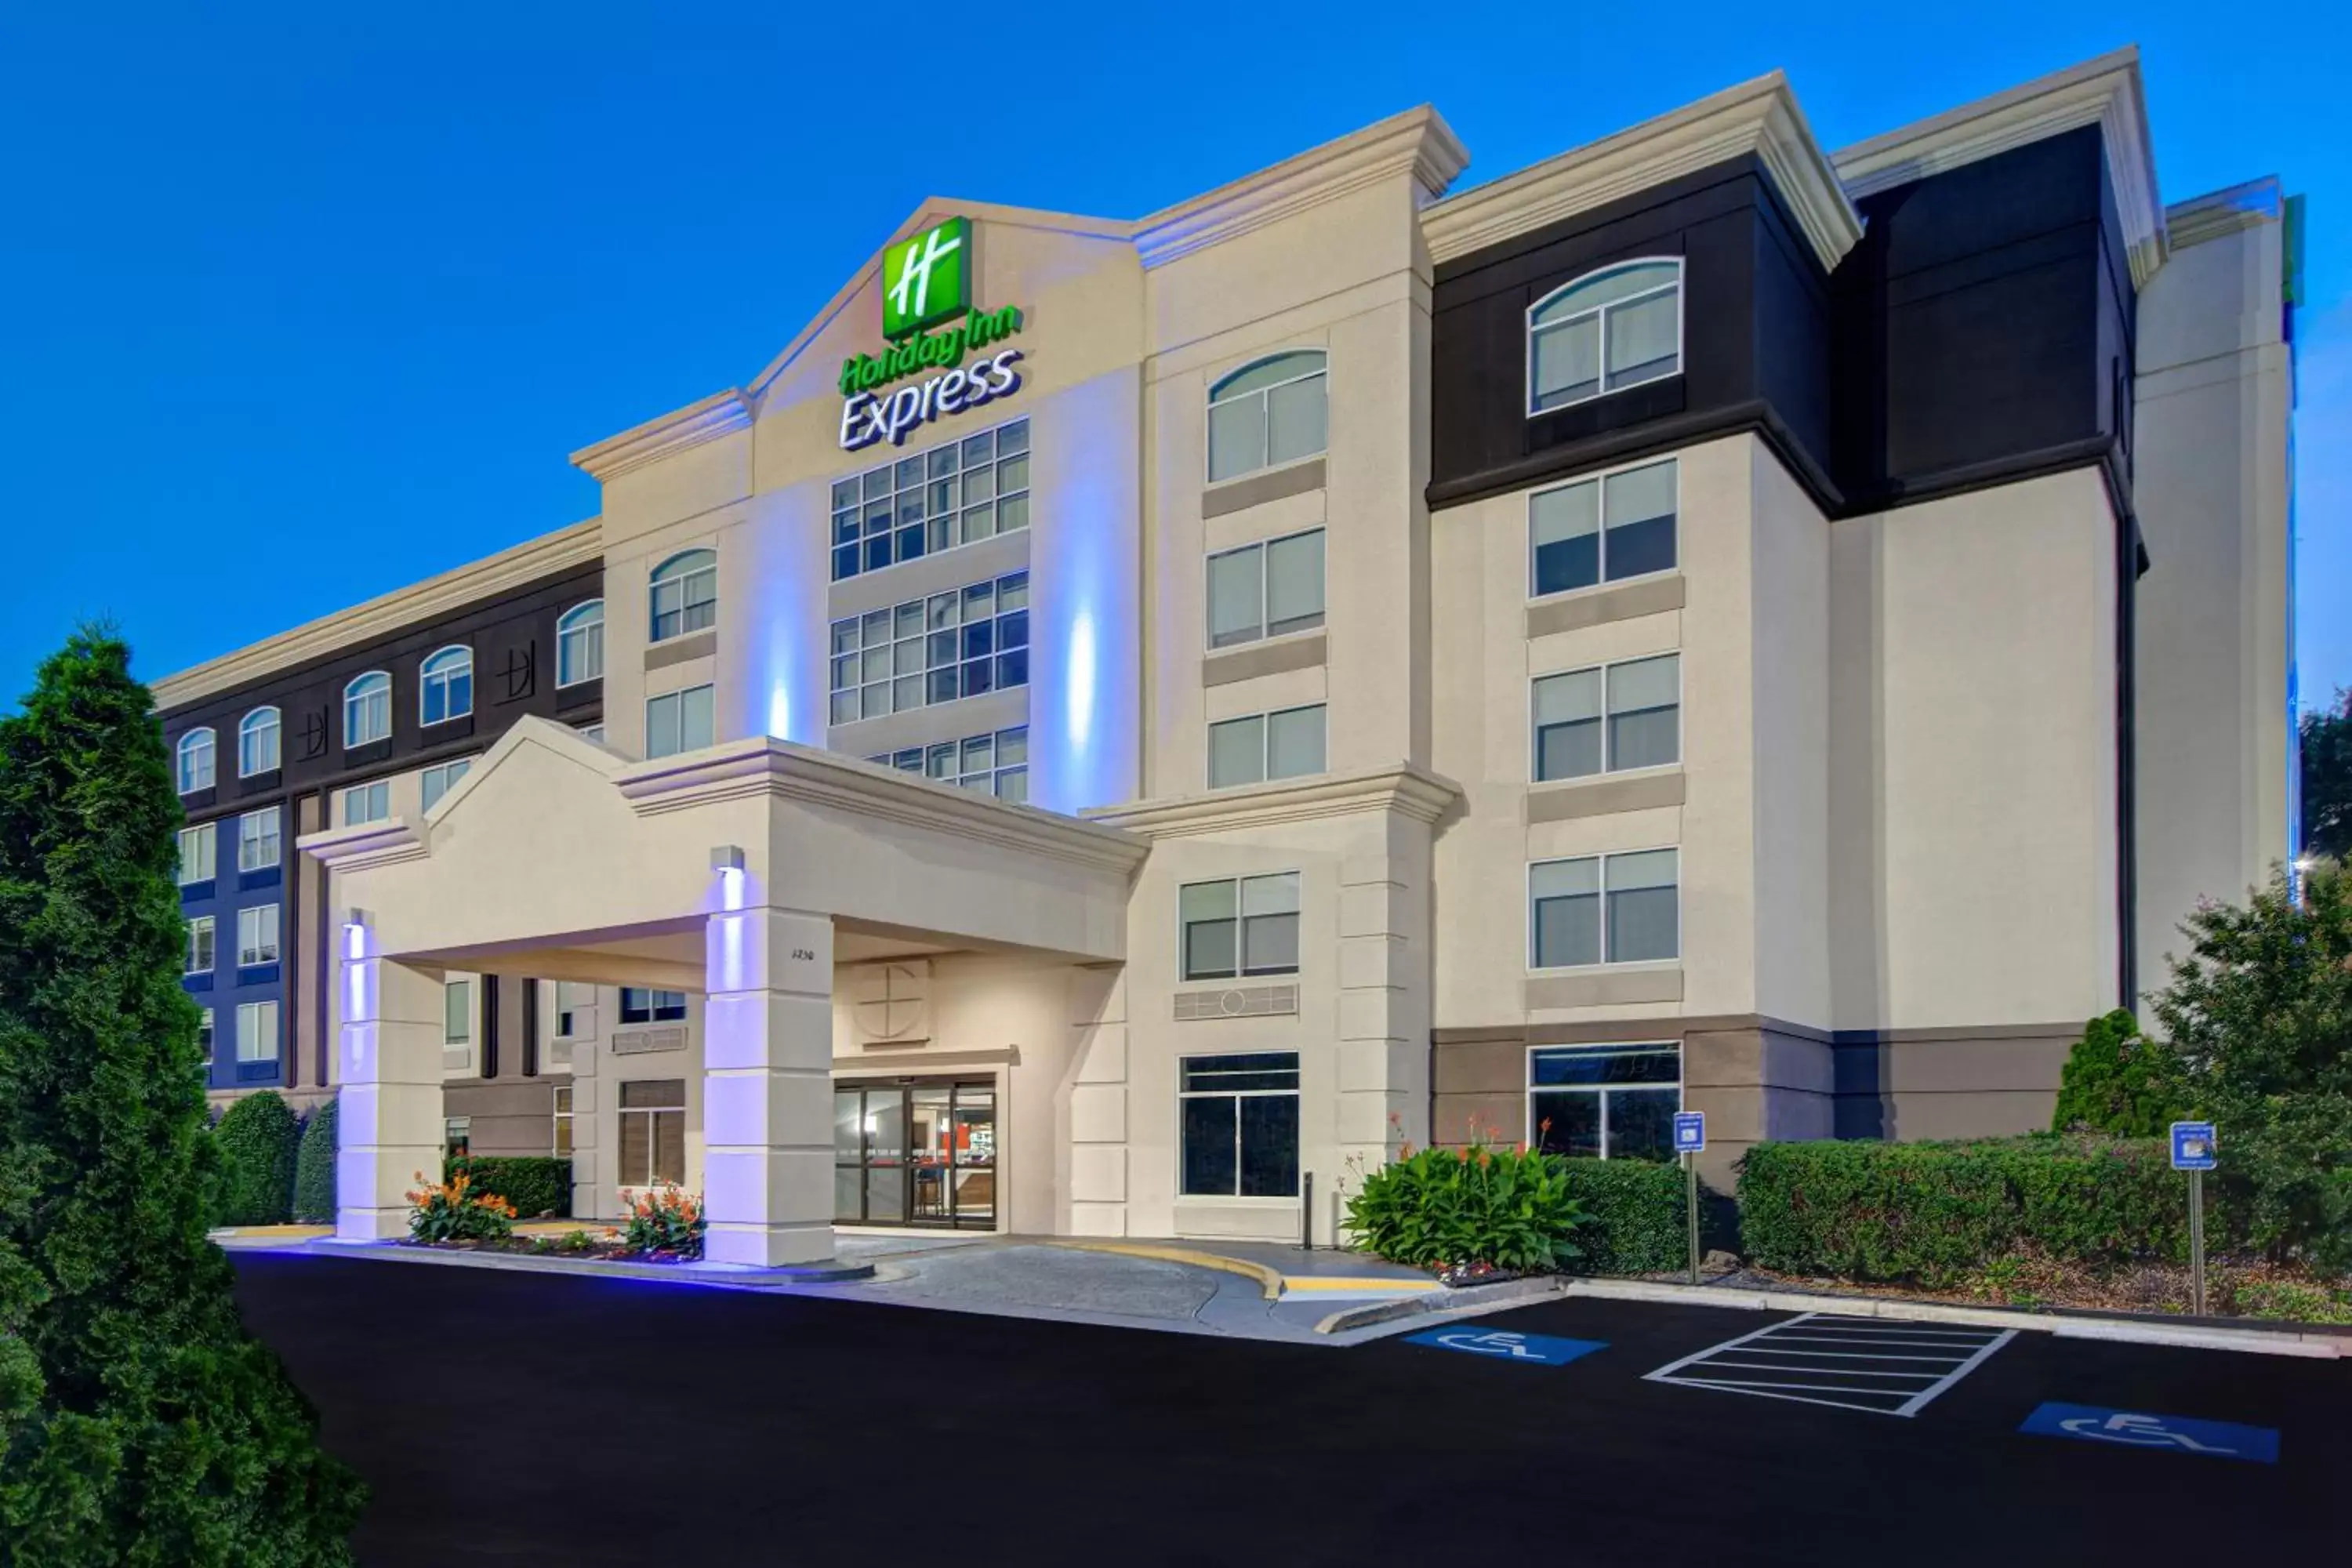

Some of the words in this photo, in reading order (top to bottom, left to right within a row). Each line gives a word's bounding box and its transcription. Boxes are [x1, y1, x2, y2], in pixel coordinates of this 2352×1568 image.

[839, 329, 964, 395] Holiday
[965, 305, 1023, 350] Inn
[840, 350, 1024, 450] Express
